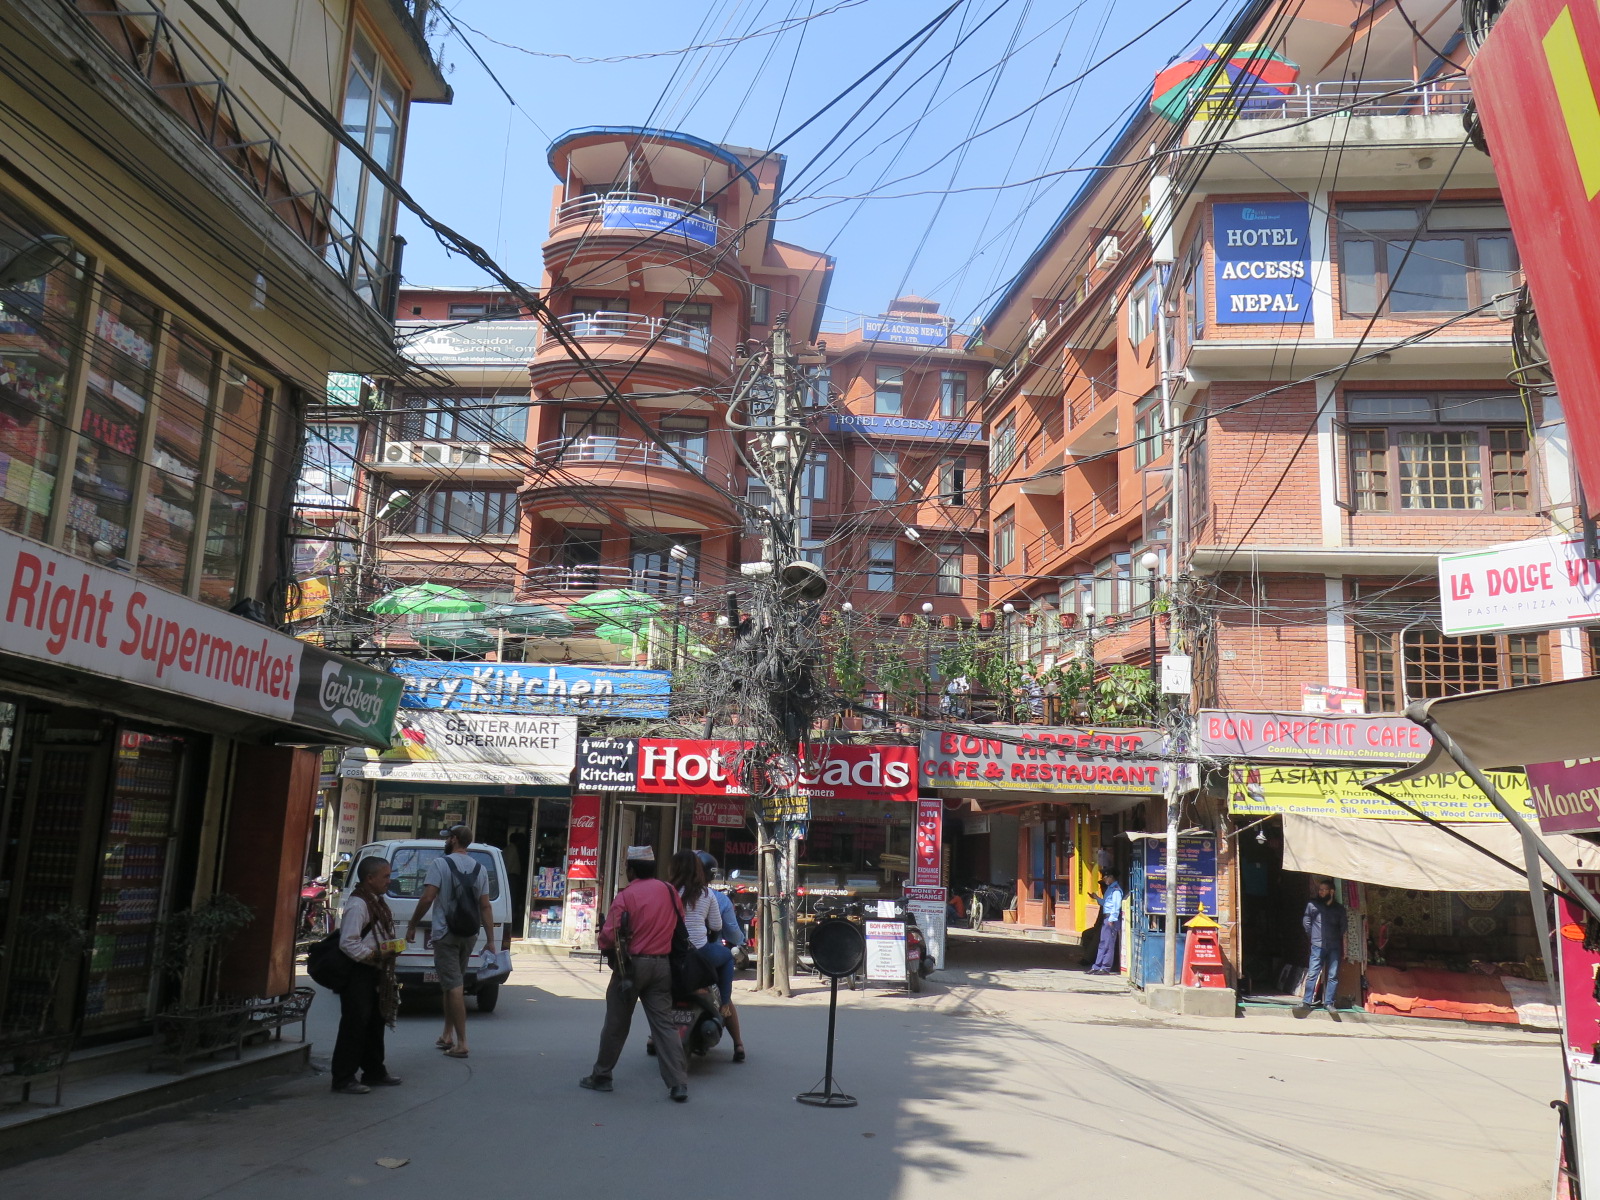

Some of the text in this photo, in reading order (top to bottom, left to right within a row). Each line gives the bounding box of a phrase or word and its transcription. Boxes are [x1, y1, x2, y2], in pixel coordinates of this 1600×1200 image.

[606, 203, 631, 214] HOTEL
[632, 206, 662, 216] ACCESS
[663, 210, 687, 222] NEPA
[1227, 228, 1299, 247] HOTEL
[1222, 261, 1305, 280] ACCESS
[1230, 293, 1300, 313] NEPAL
[866, 322, 944, 338] HOTEL ACCESS NEPAL
[423, 334, 514, 346] Ambassador
[836, 415, 879, 427] HOTEL
[882, 419, 934, 431] ACCESS
[1450, 573, 1475, 601] LA
[1486, 562, 1554, 597] DOLCE
[1467, 605, 1508, 617] PASTA
[1518, 600, 1557, 611] PIZZA
[5, 550, 294, 701] Right Supermarket
[319, 660, 384, 727] Carlsberg
[469, 666, 614, 706] Kitchen
[1320, 687, 1347, 696] Belgian
[446, 719, 560, 735] CENTER MART
[1207, 717, 1254, 742] BON
[1365, 724, 1422, 749] CAFE
[444, 733, 560, 750] SUPERMARKET
[591, 741, 624, 750] WAY TO
[940, 731, 1003, 756] BON
[1267, 745, 1323, 757] Continental,
[587, 751, 629, 769] Curry
[641, 746, 727, 782] Hot
[473, 773, 507, 781] GROCERY
[580, 767, 634, 782] Kitchen
[922, 759, 1160, 784] CAFE & RESTAURANT
[1270, 768, 1338, 785] ASIAN
[578, 782, 637, 792] Restaurant
[1389, 792, 1460, 800] Kathmandu,
[1533, 783, 1600, 823] Money
[343, 801, 359, 811] CENTER
[694, 802, 717, 817] 50%
[1233, 804, 1286, 813] Pashmina's,
[1289, 805, 1338, 814] Cashmere,
[1340, 806, 1360, 814] Silk,
[1363, 808, 1409, 816] Sweaters,
[1440, 810, 1466, 818] Wood
[341, 826, 355, 835] SUPER
[924, 810, 938, 865] MONEY
[340, 839, 356, 847] MARKET
[580, 845, 598, 857] Mart
[574, 858, 597, 866] Market
